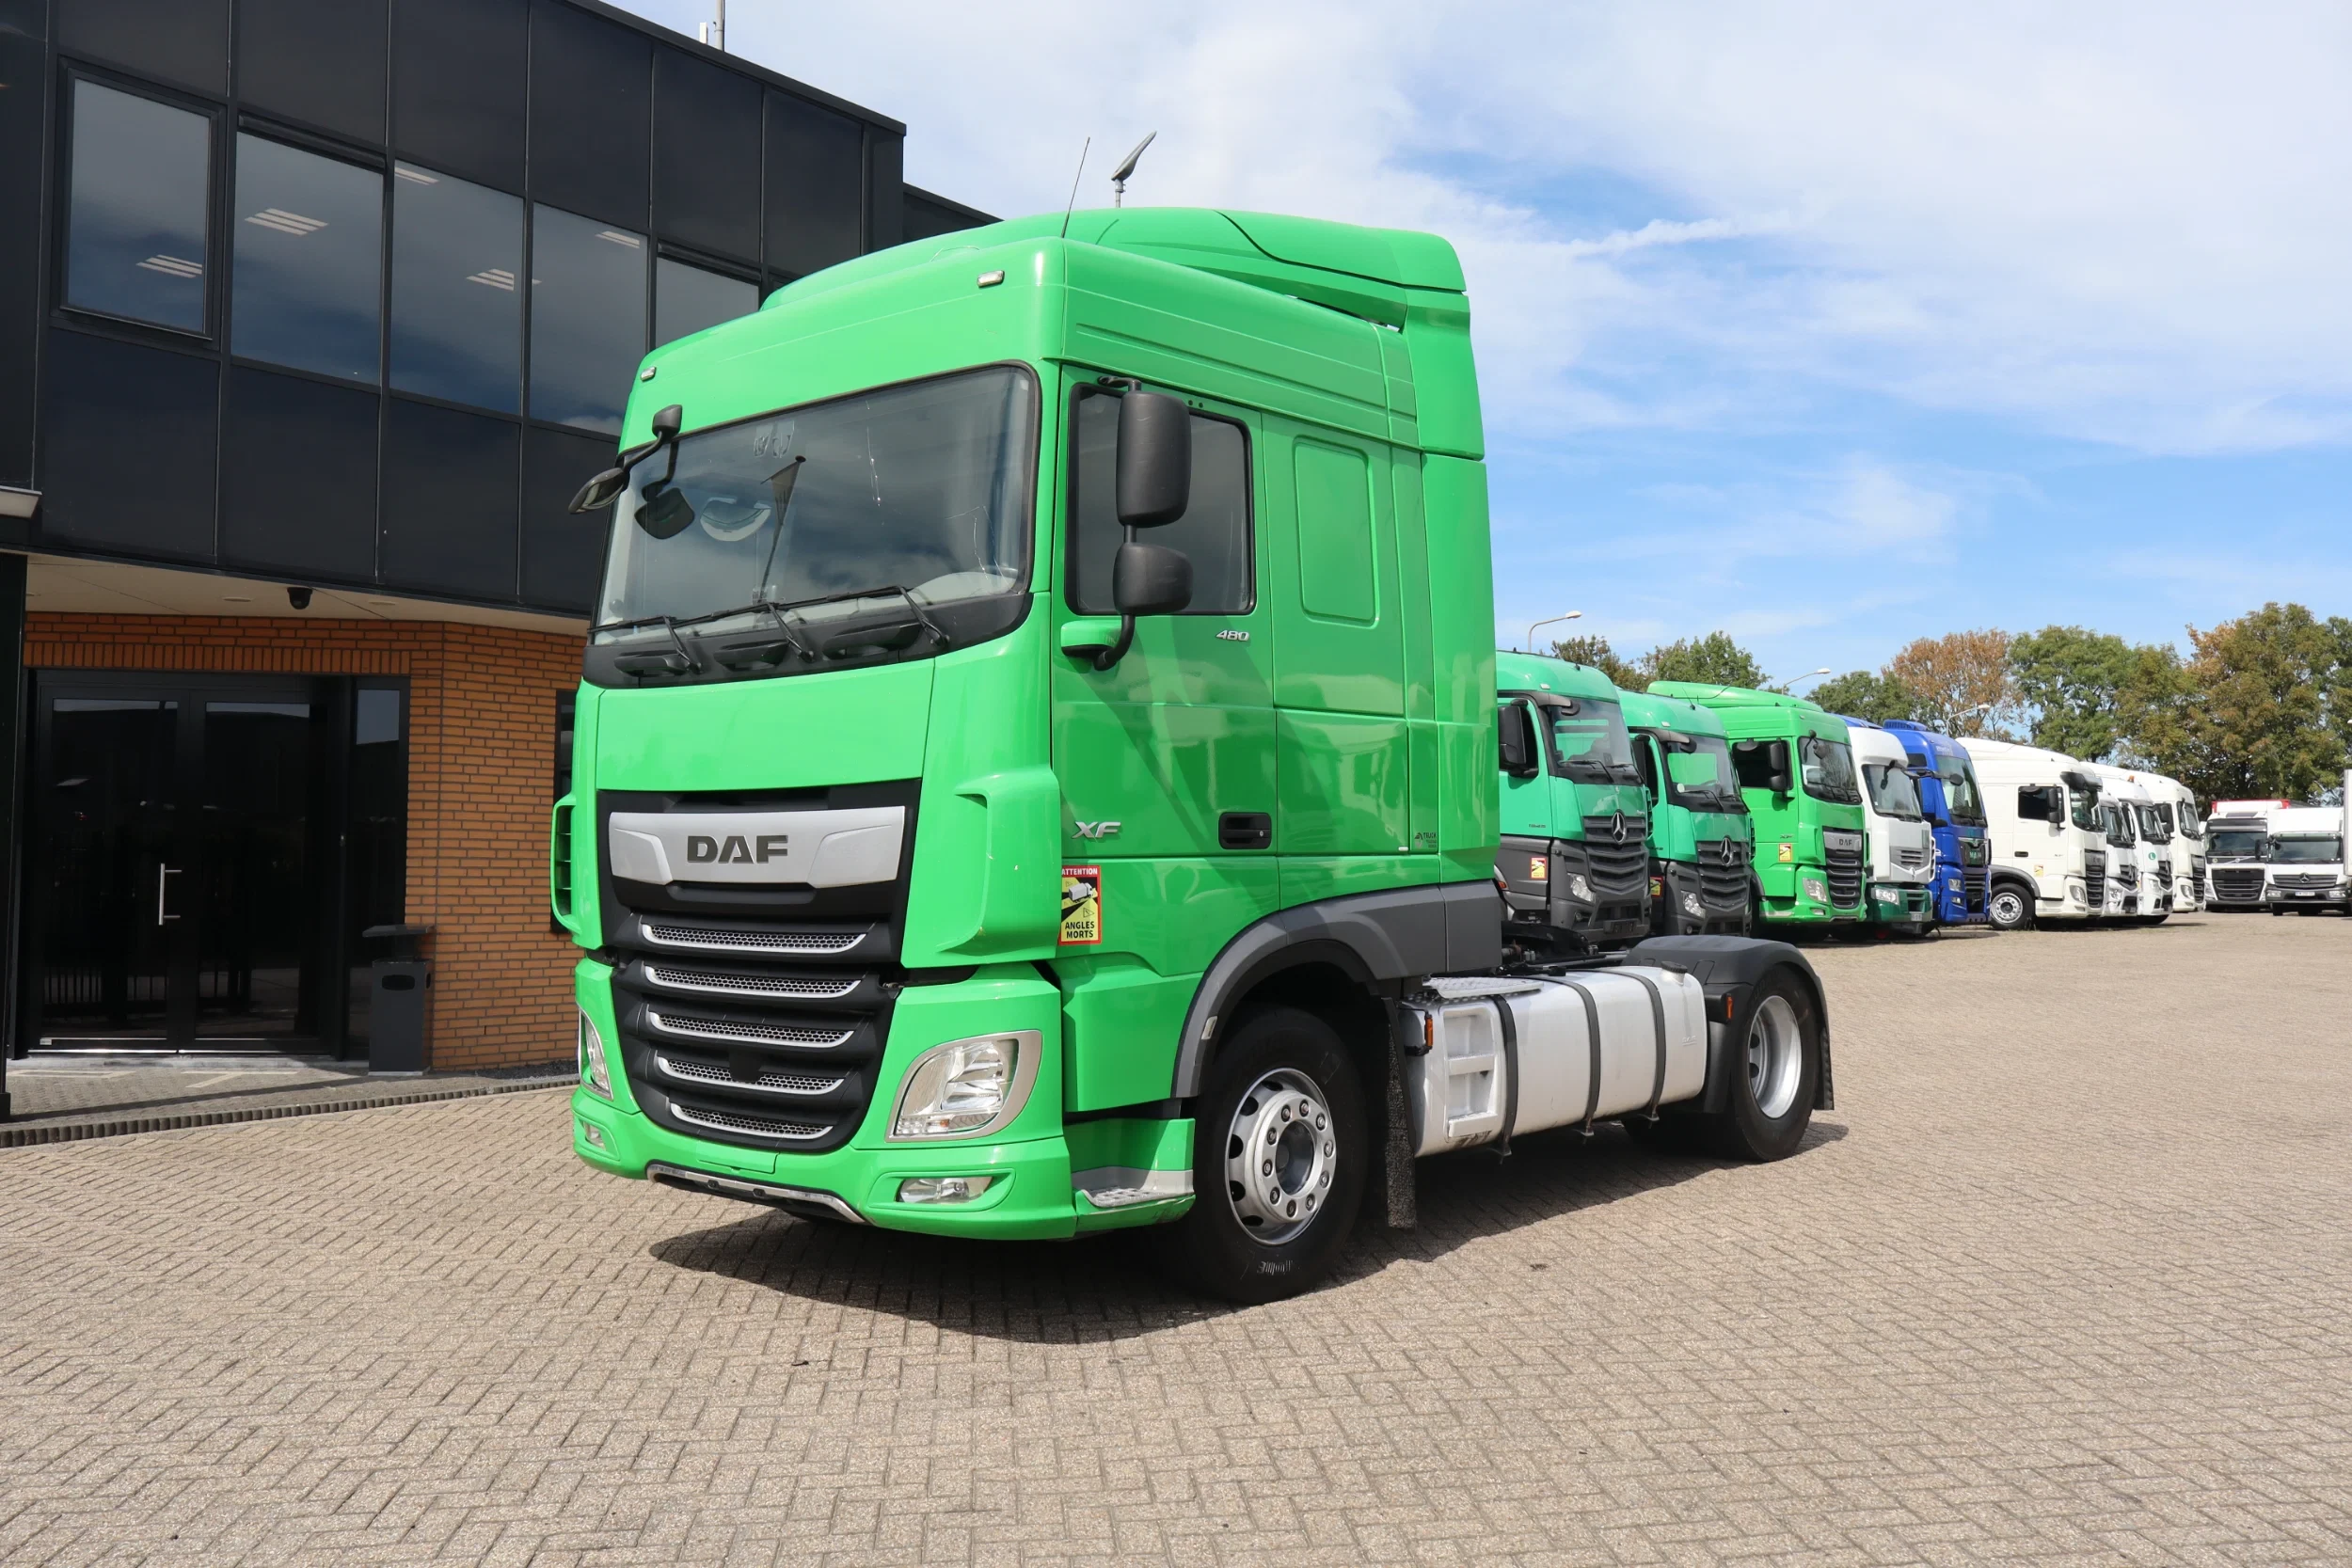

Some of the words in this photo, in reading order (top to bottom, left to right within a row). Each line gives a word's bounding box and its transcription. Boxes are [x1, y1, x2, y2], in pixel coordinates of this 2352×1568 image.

[1216, 629, 1249, 641] 480
[1073, 821, 1121, 838] XF
[1838, 838, 1852, 847] DAF
[687, 834, 789, 864] DAF
[1064, 921, 1095, 930] ANGLES
[1066, 930, 1094, 939] MORTS
